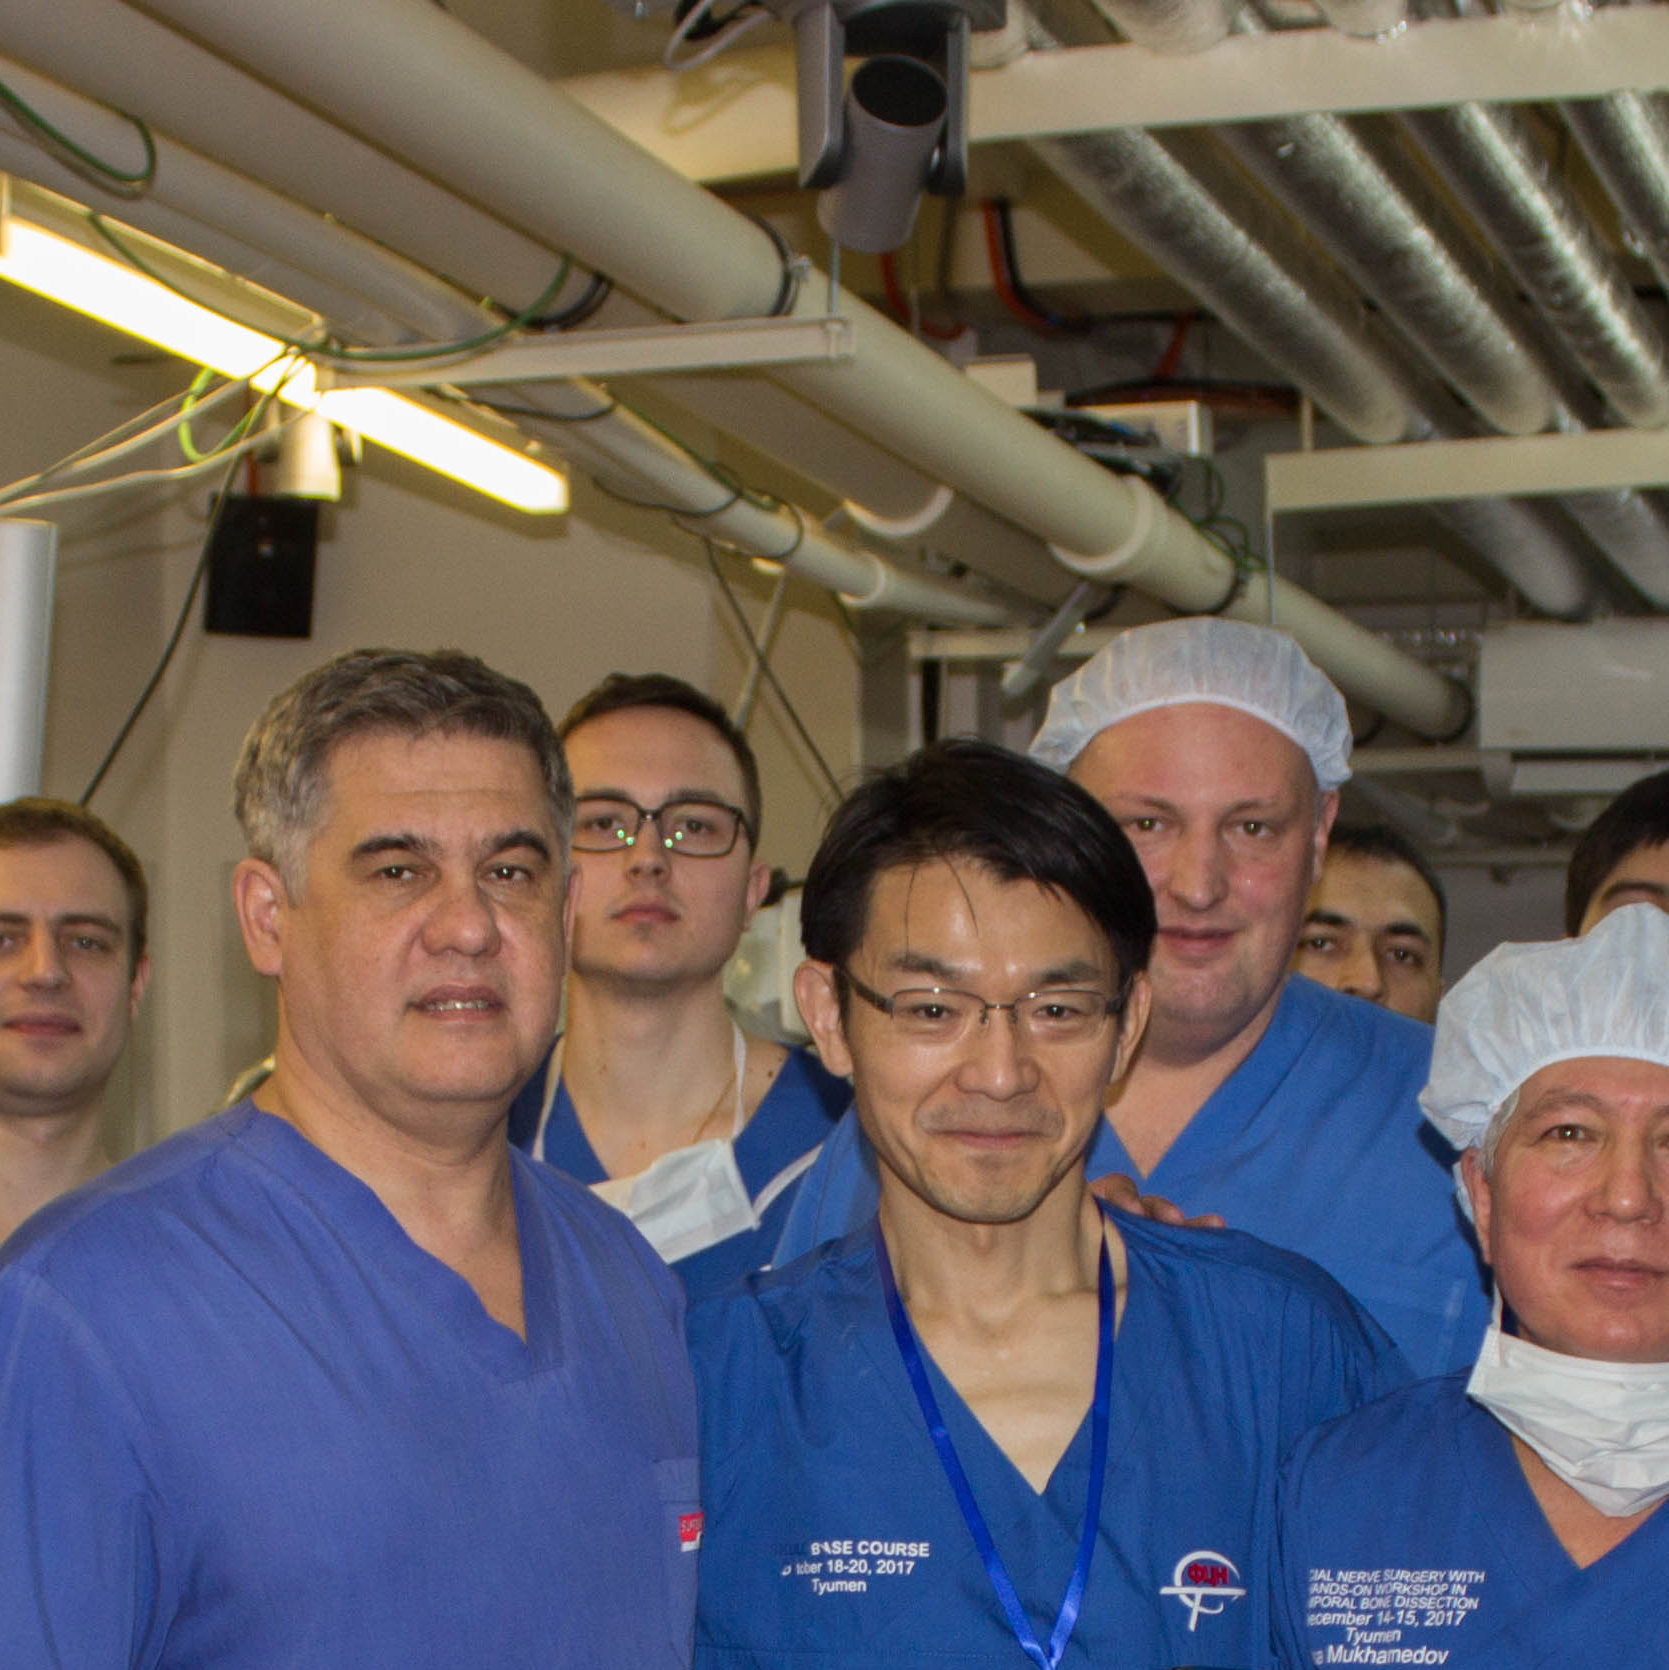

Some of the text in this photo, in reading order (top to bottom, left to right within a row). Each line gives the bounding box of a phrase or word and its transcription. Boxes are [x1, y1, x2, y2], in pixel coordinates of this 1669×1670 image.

[857, 1540, 930, 1558] COURSE
[827, 1558, 872, 1576] 18-20,
[876, 1559, 915, 1575] 2017
[1187, 1562, 1229, 1588] ФЦН
[1337, 1570, 1381, 1583] NERVE
[1384, 1569, 1446, 1583] SURGERY
[1450, 1570, 1486, 1583] WITH
[811, 1578, 867, 1596] Tyumen
[1375, 1582, 1450, 1596] WORKSHOP
[1451, 1583, 1468, 1595] IN
[1360, 1596, 1392, 1609] BONE
[1394, 1596, 1480, 1609] DISSECTION
[1377, 1610, 1420, 1627] 14-15,
[1424, 1610, 1468, 1626] 2017
[1345, 1627, 1402, 1646] Tyumen
[1327, 1645, 1450, 1665] Mukhamedov
